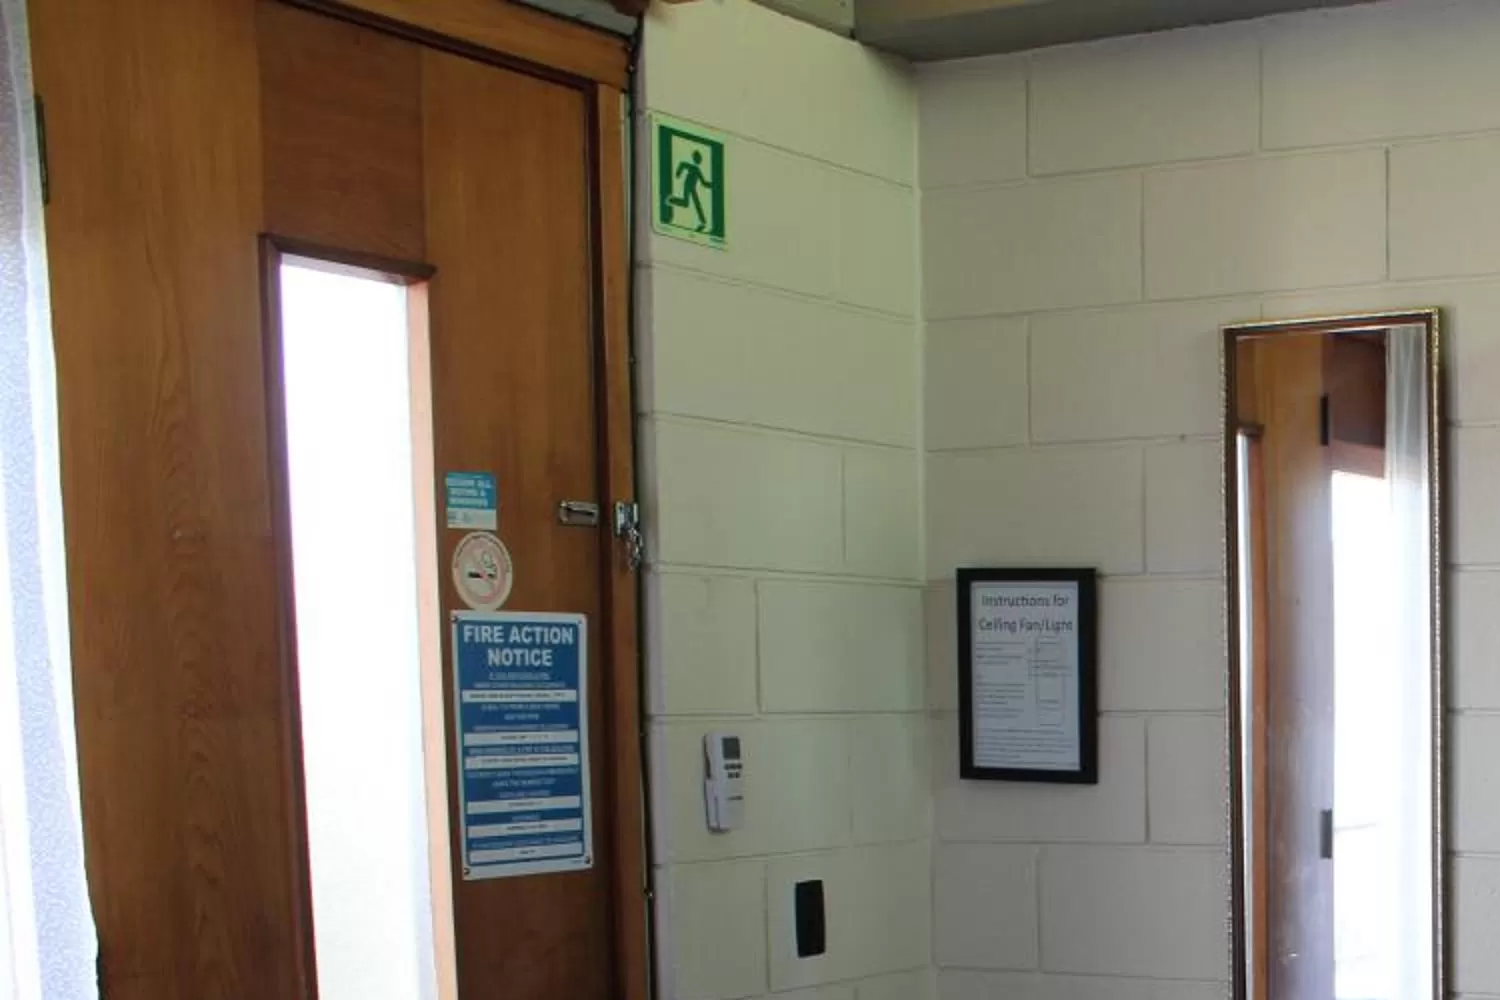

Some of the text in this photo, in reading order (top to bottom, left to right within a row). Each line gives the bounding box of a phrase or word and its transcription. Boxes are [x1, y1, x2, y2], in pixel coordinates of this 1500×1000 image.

[981, 593, 1070, 607] Instructions for
[463, 624, 574, 645] FIRE ACTION
[978, 617, 1073, 635] Ceiling Fan/Light
[487, 648, 553, 667] NOTICE
